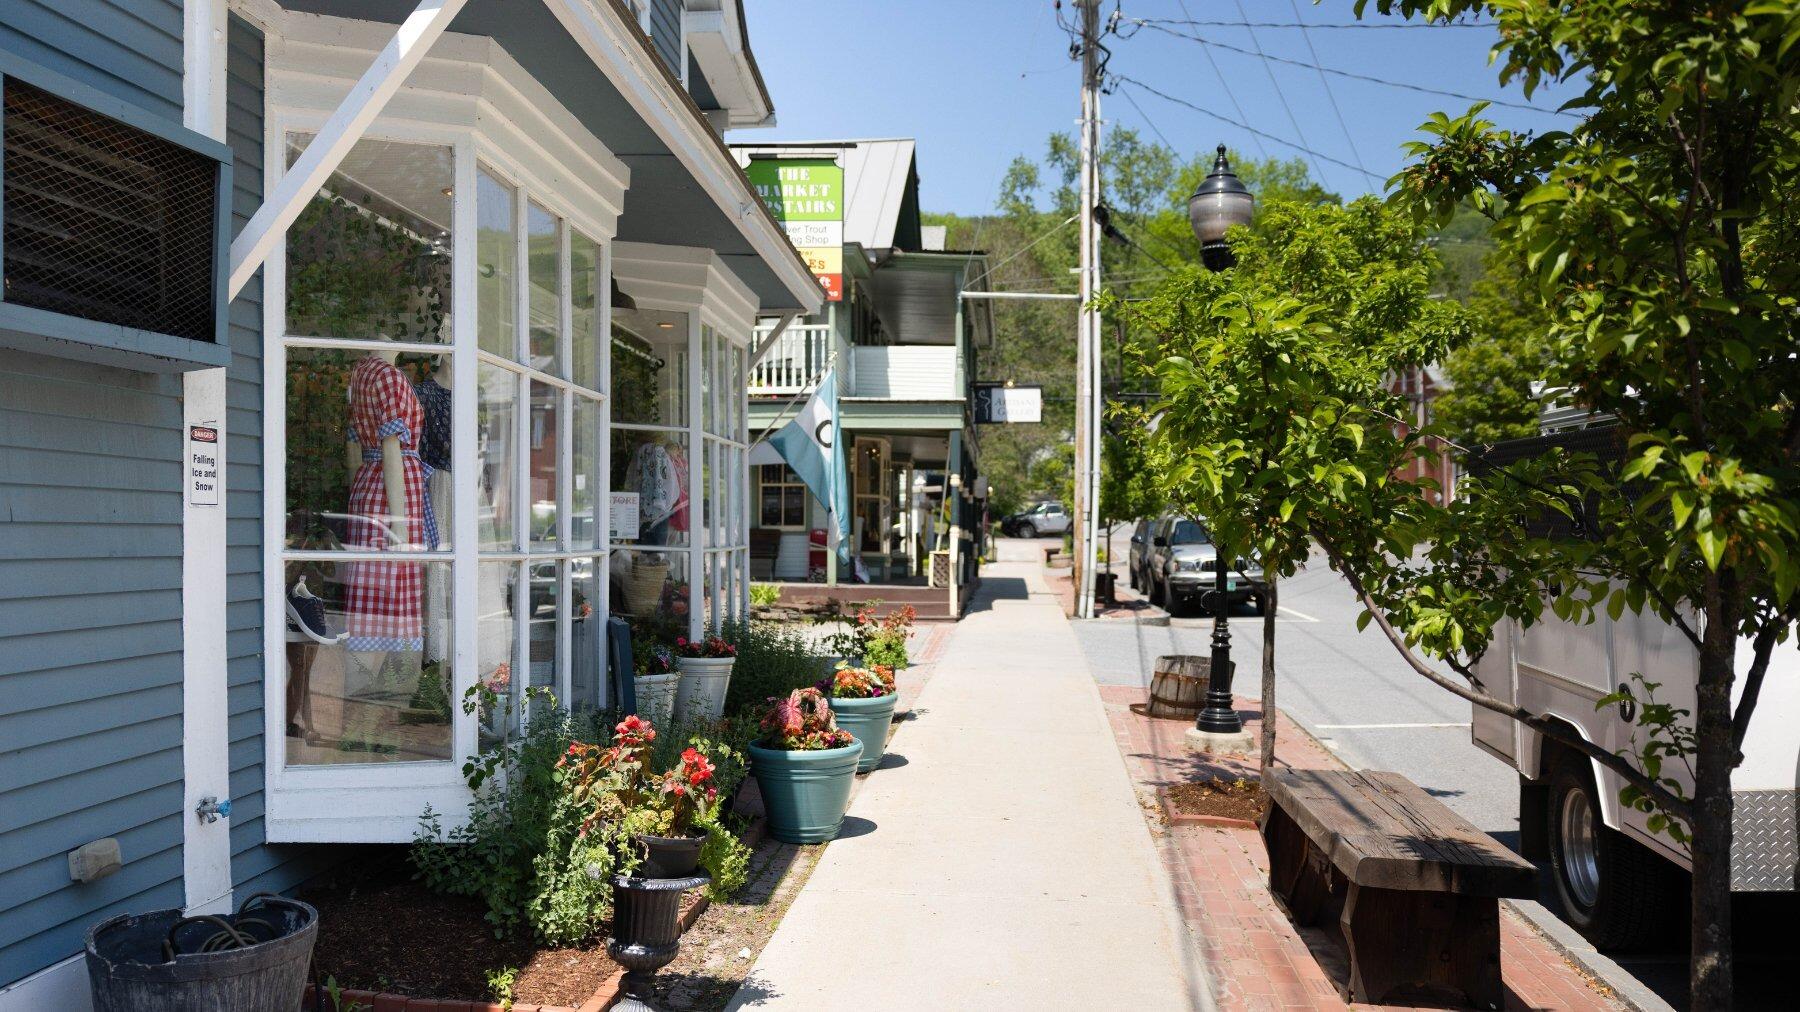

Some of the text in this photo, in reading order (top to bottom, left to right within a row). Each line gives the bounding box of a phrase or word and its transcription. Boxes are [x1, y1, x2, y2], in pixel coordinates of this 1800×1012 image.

[775, 168, 810, 181] THE
[765, 200, 836, 214] PSTAIRS
[804, 225, 827, 234] Trout
[805, 235, 829, 245] Shop
[194, 430, 214, 439] DANGER
[193, 454, 215, 466] Falling
[192, 467, 216, 478] Ice and
[195, 481, 214, 491] Snow
